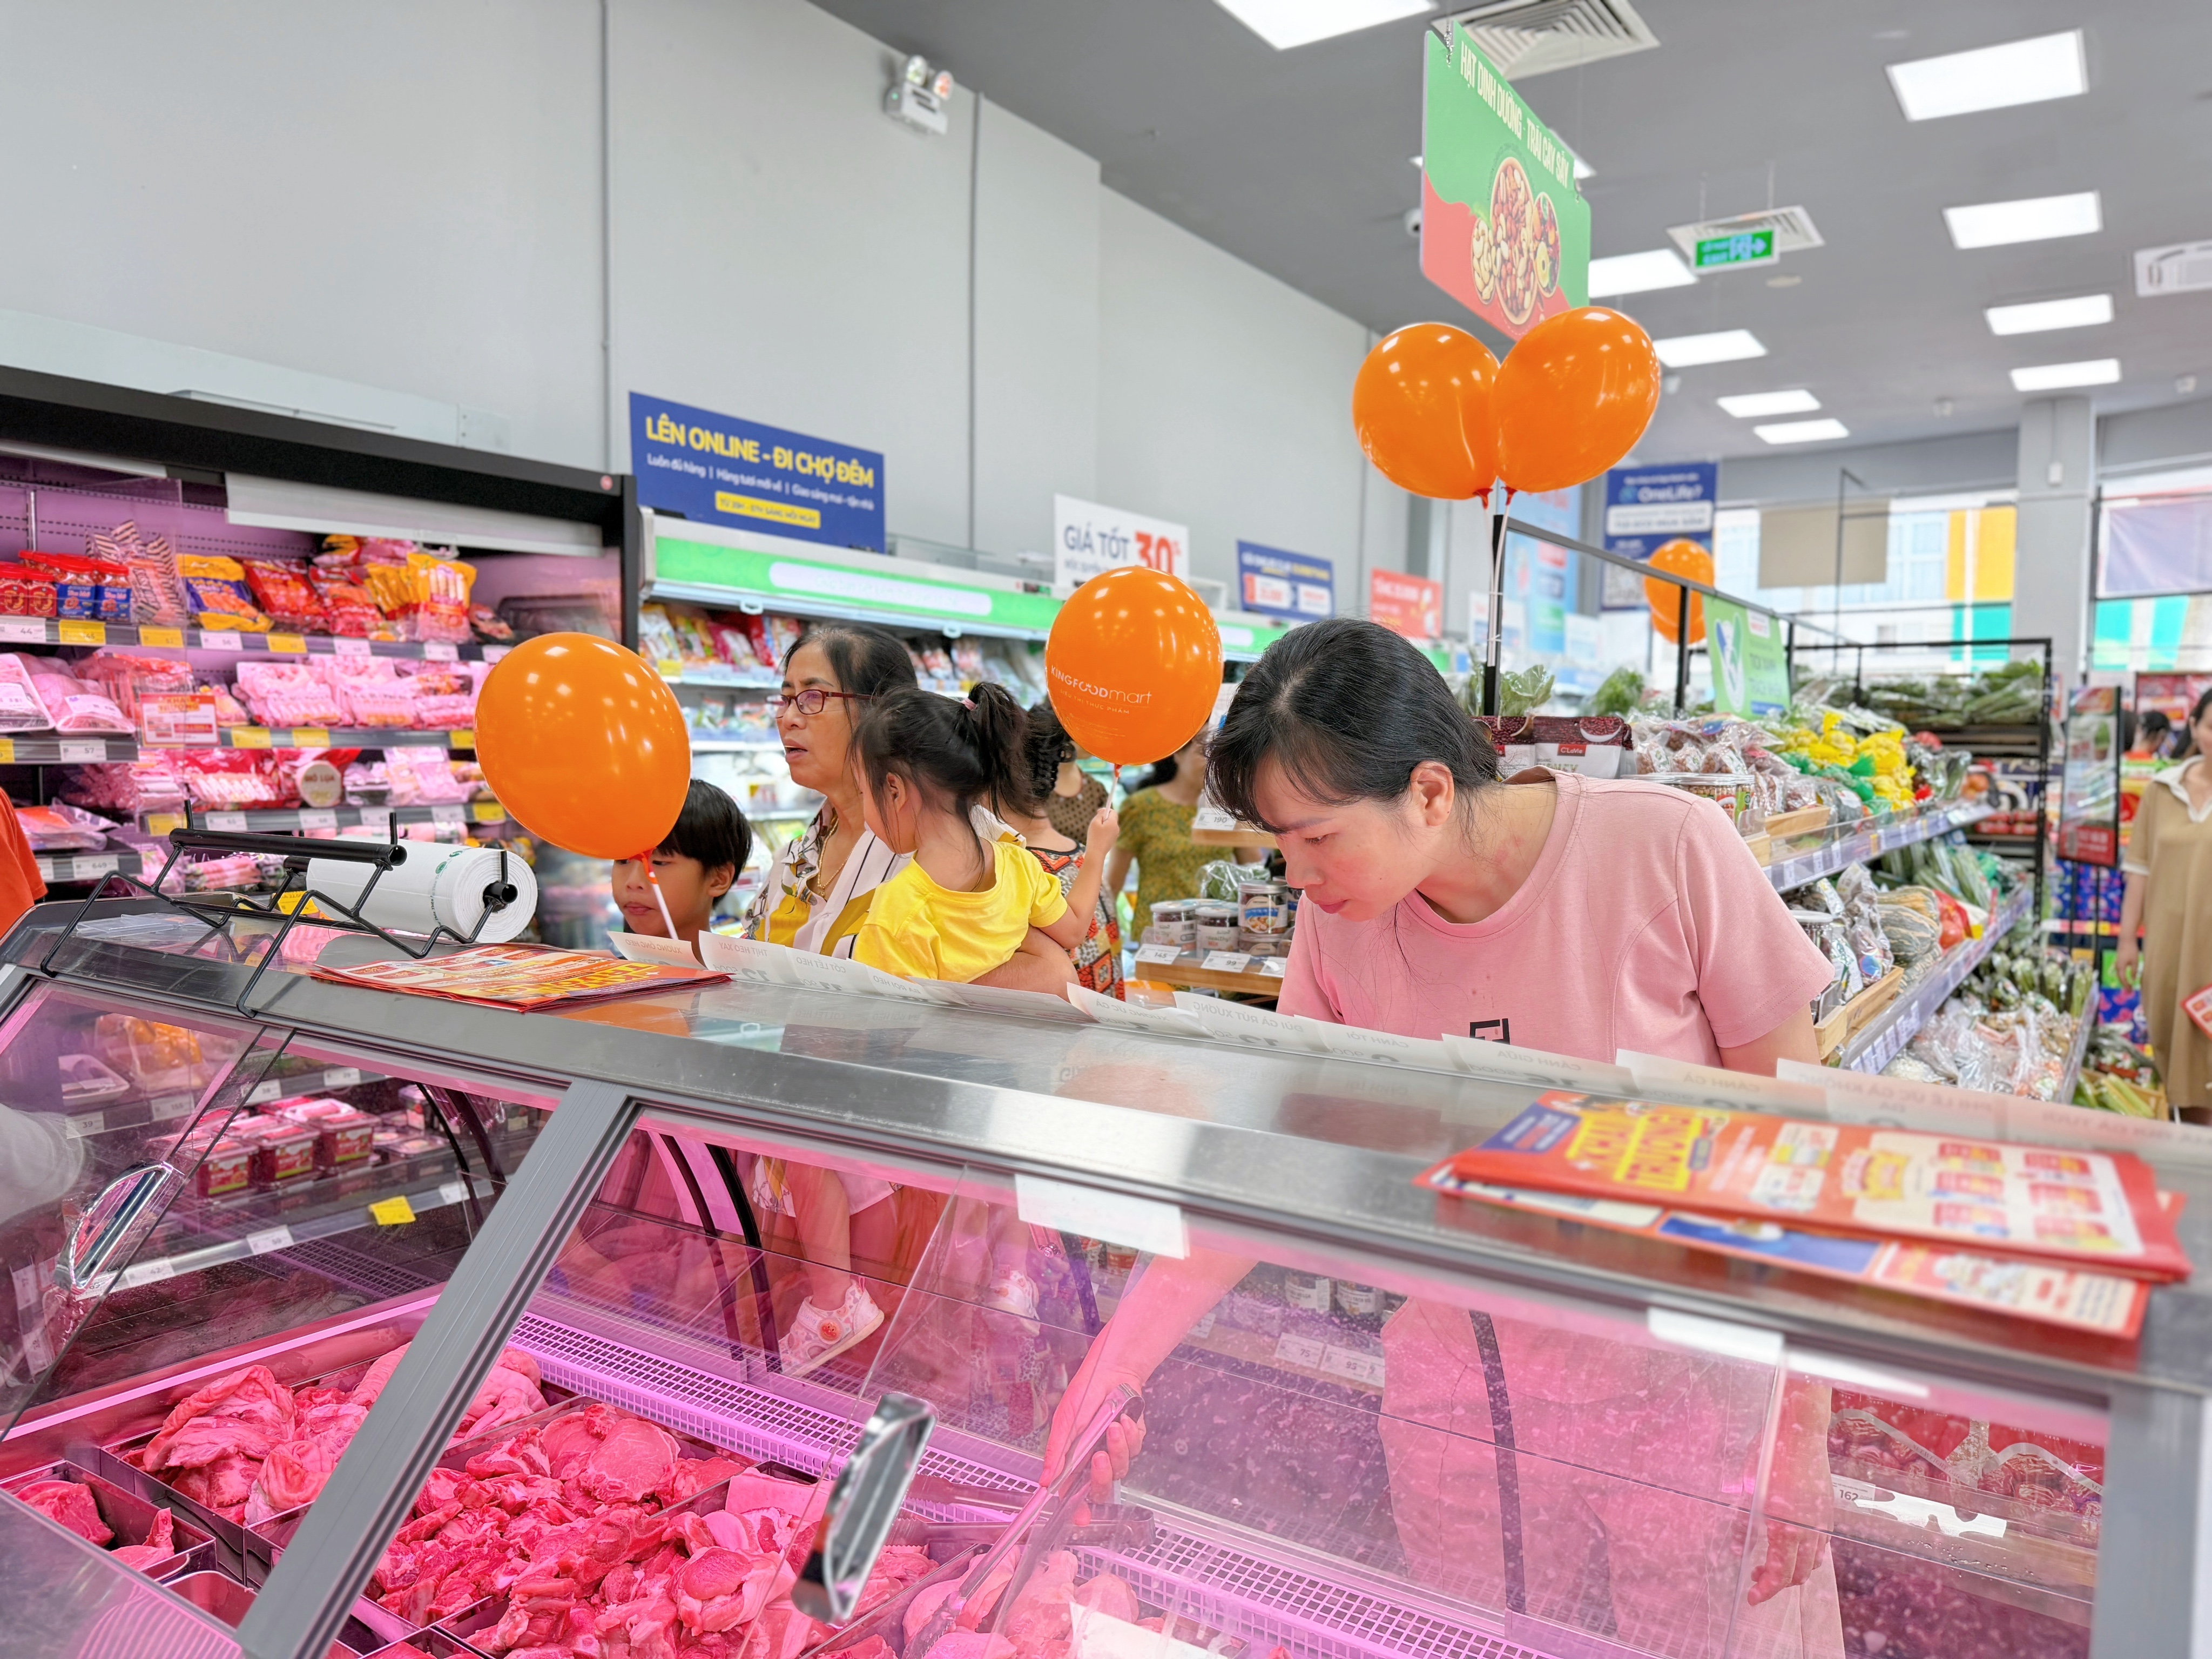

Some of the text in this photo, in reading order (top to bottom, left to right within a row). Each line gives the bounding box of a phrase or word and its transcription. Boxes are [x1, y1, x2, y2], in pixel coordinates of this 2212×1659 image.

[1460, 40, 1477, 89] HẠT
[1478, 60, 1497, 112] DINH
[1497, 83, 1522, 140] DƯỠNG
[1527, 117, 1542, 162] TRÁI
[1542, 136, 1556, 174] CÂY
[1556, 150, 1569, 189] SẤY
[646, 413, 685, 446] LÊN
[689, 427, 760, 463] ONLINE
[772, 446, 794, 470] ĐI
[795, 451, 835, 484] CHỢ
[836, 458, 874, 488] ĐÊM
[1064, 522, 1094, 554] GIÁ
[1097, 527, 1130, 561] TỐT
[1839, 1489, 1859, 1501] 162
